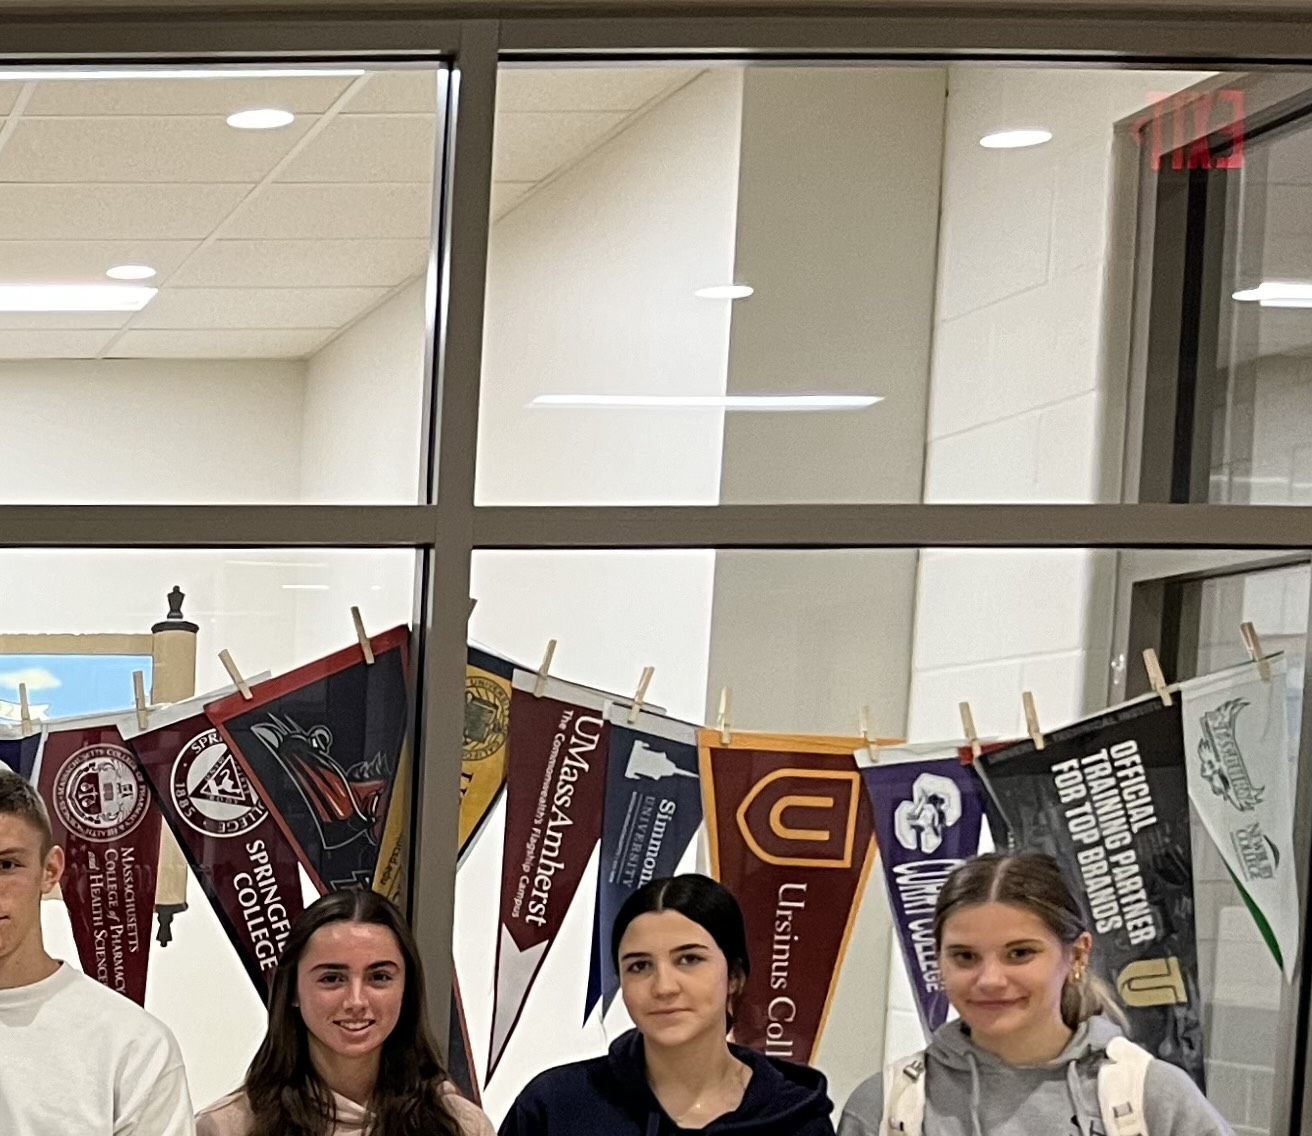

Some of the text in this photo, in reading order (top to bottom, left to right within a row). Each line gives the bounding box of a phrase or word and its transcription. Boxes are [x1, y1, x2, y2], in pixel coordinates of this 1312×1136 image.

[558, 709, 574, 731] The
[174, 782, 195, 819] 1885
[1109, 739, 1158, 834] OFFICIAL
[521, 827, 542, 873] Flagship
[622, 795, 656, 888] UNIVERSITY
[1051, 757, 1124, 935] FOR TOP BRANDS
[1081, 748, 1157, 946] TRAINING PARTNER
[89, 873, 104, 926] HEALTH
[104, 848, 126, 993] COLLEGE of PHARMACY
[121, 847, 139, 953] MASSACHUSETTS
[232, 872, 279, 972] COLLEGE
[511, 875, 530, 918] Campus
[773, 882, 809, 991] Ursinus
